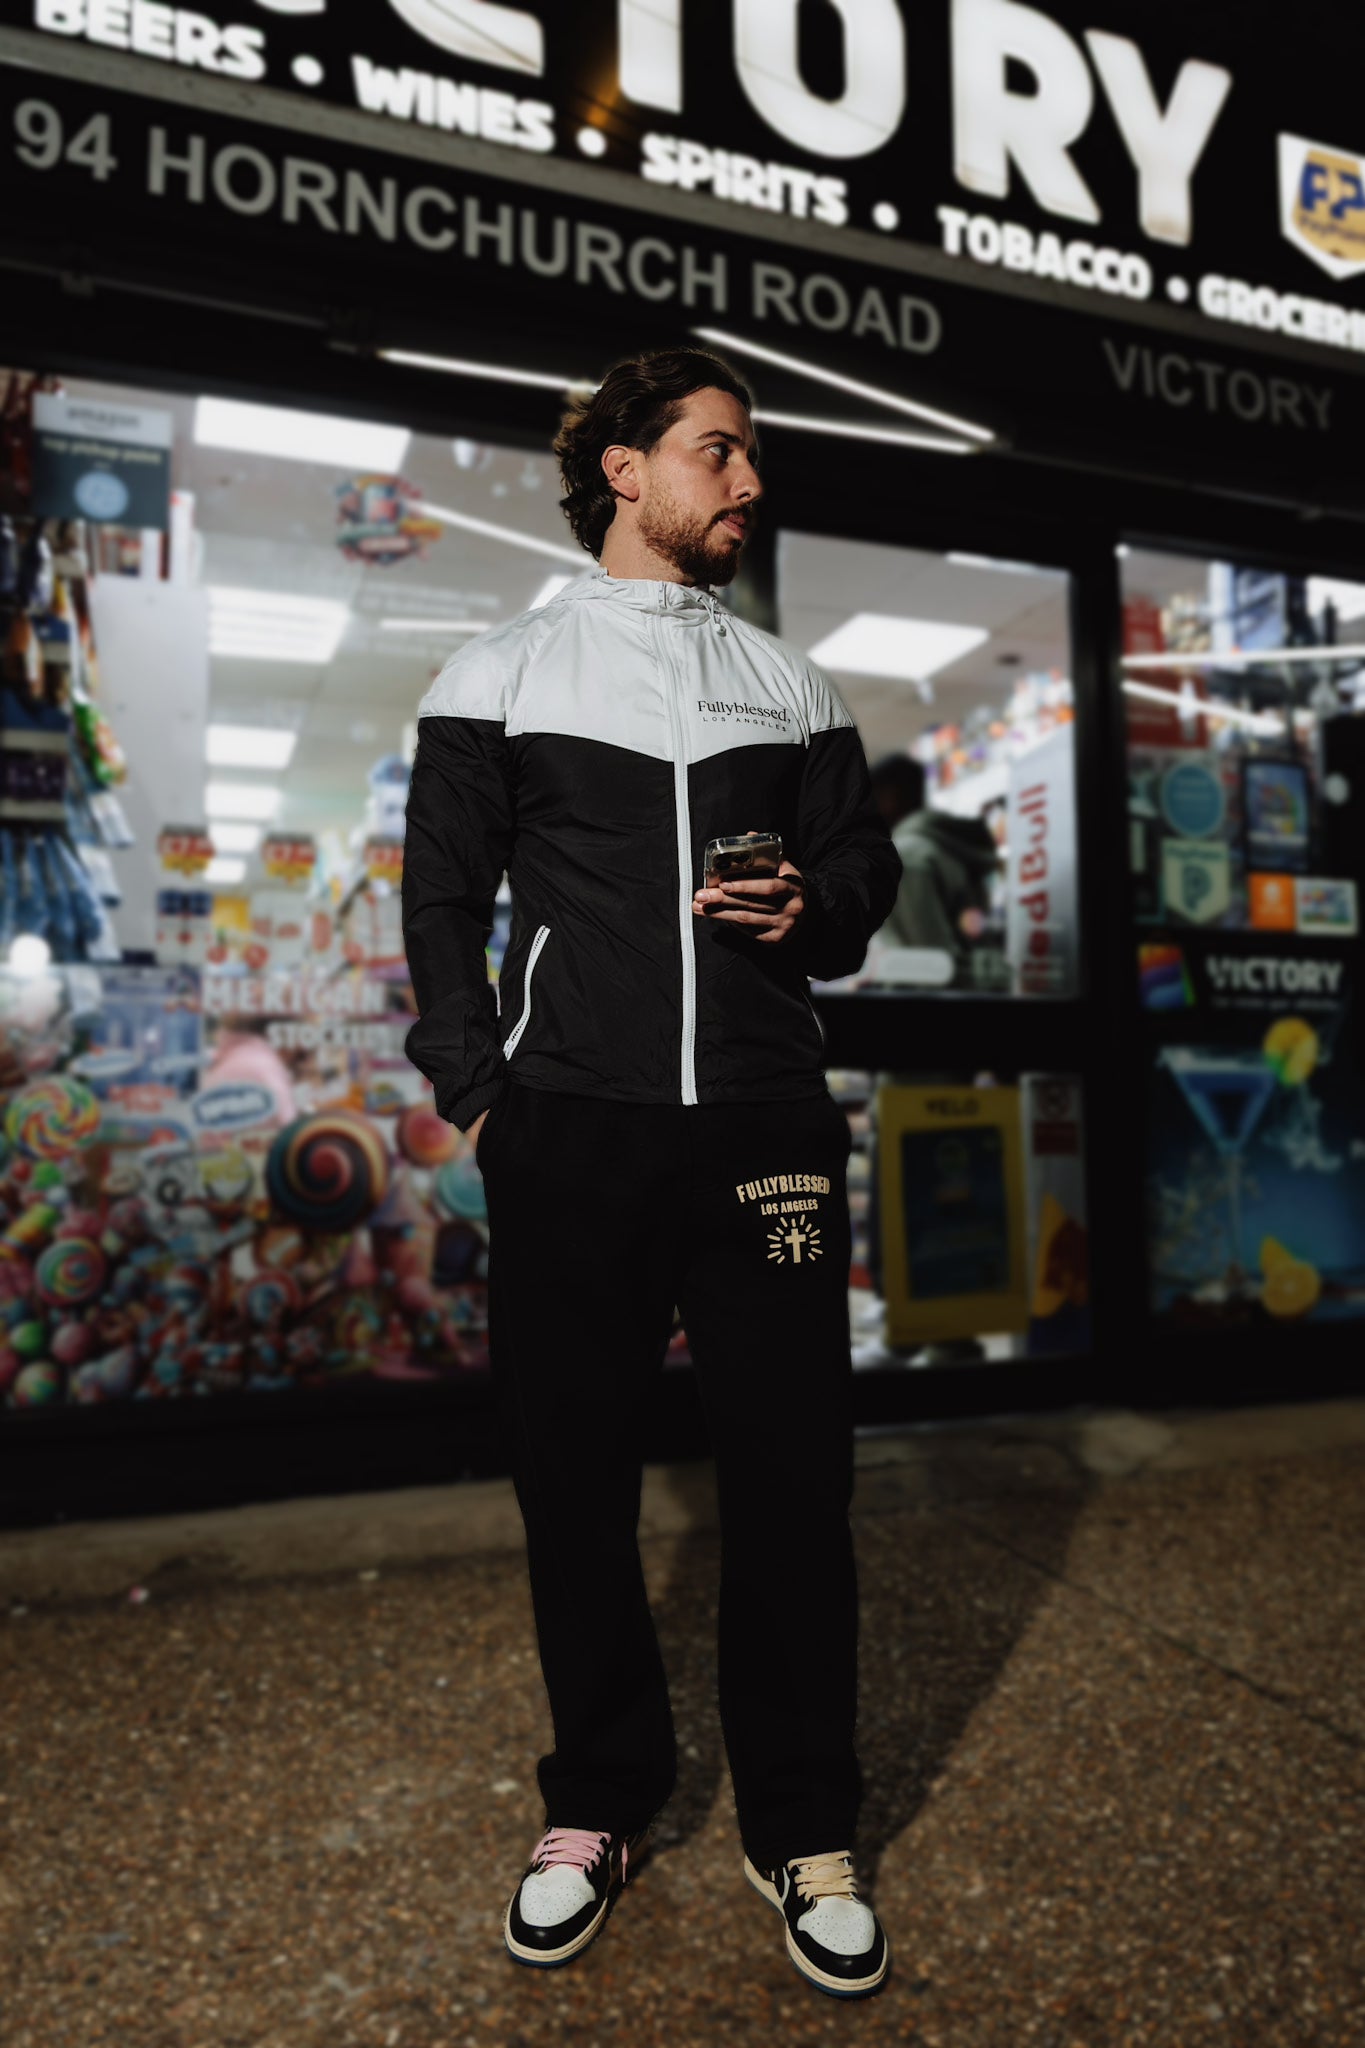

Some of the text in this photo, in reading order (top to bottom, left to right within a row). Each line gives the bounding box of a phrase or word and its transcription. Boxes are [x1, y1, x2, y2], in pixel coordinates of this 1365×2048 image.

[33, 0, 268, 81] BEERS
[350, 53, 557, 154] WINES
[639, 131, 849, 228] SPIRITS
[936, 203, 1153, 302] TOBACCO
[13, 98, 943, 356] 94 HORNCHURCH ROAD
[1102, 336, 1334, 431] VICTORY
[735, 717, 787, 732] ANGELES
[1018, 783, 1048, 887] Bull
[1207, 956, 1341, 991] VICTORY
[735, 1174, 831, 1204] FULLYBLESSED
[760, 1198, 819, 1216] LOS ANGELES
